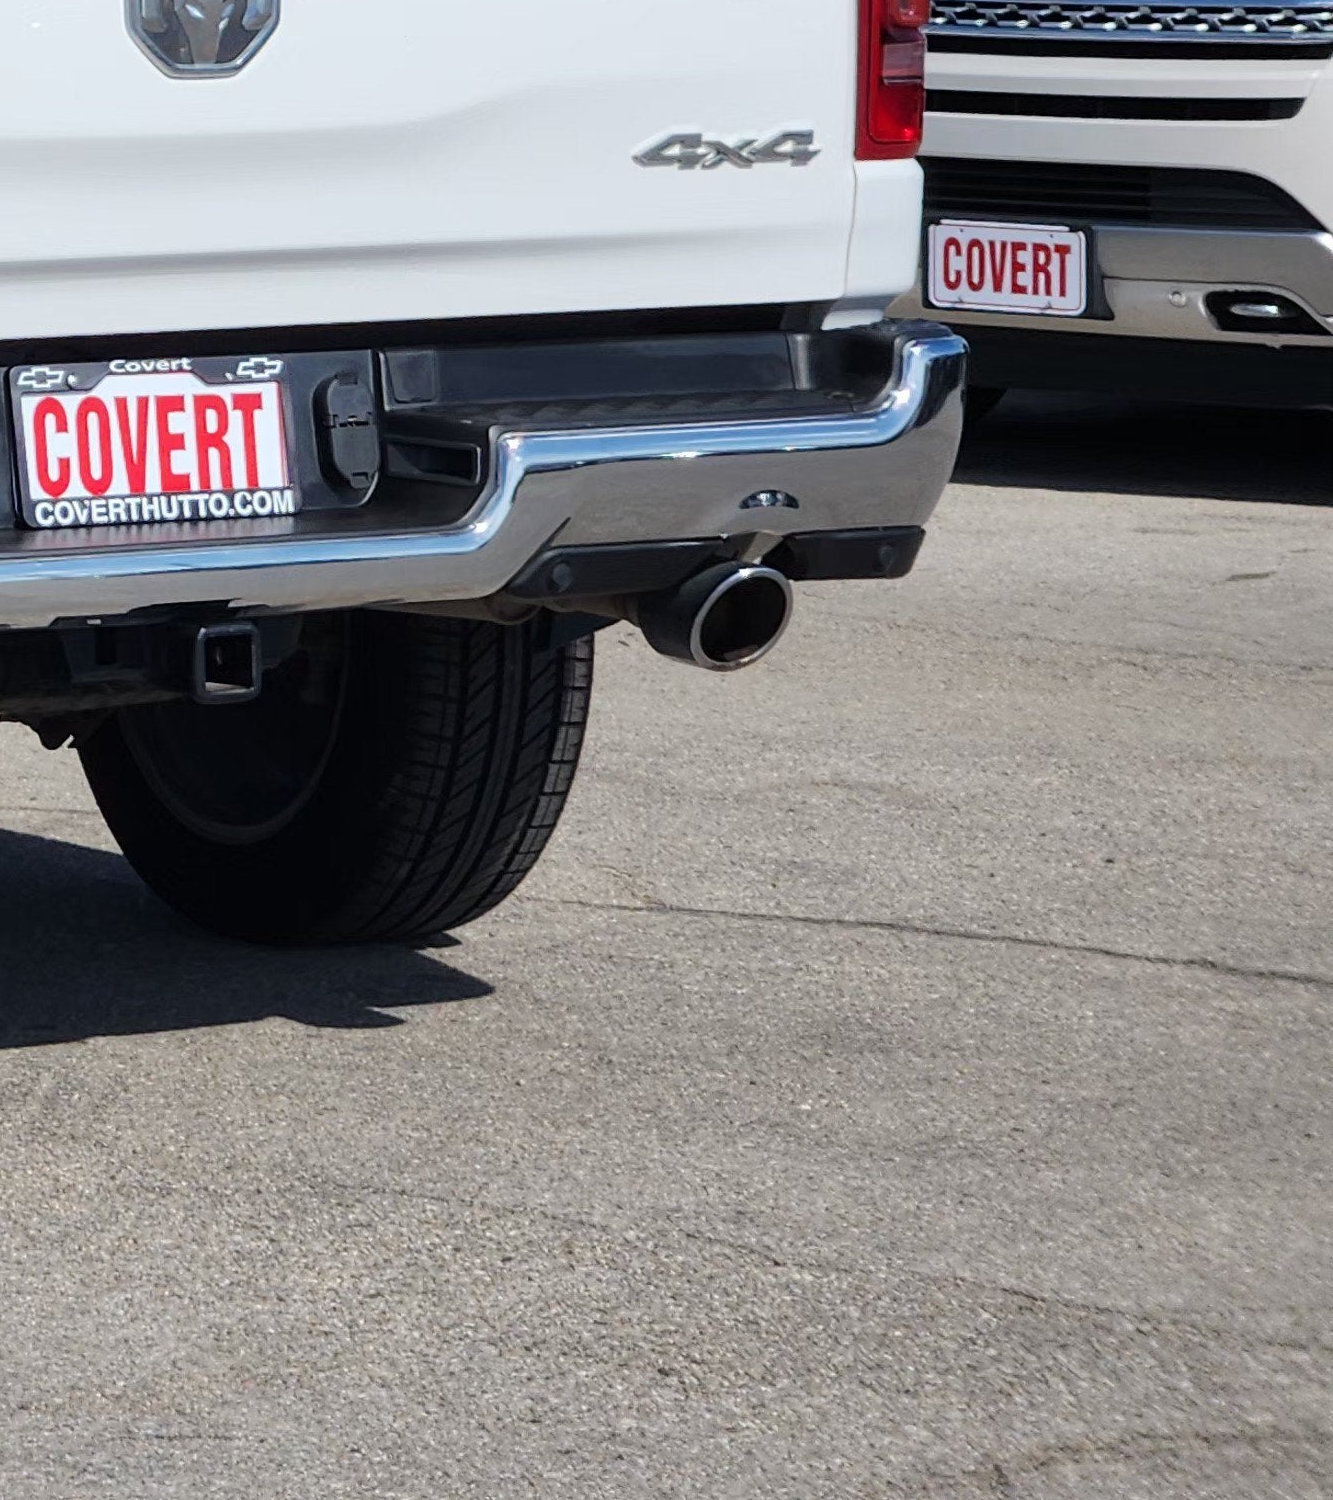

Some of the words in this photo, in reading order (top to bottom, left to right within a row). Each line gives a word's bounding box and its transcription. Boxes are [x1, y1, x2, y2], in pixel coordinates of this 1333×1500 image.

[631, 128, 822, 171] 4x4
[943, 236, 1072, 298] COVERT
[108, 357, 192, 374] Covert
[33, 392, 263, 499] COVERT
[34, 489, 296, 528] COVERTHUTTO.COM
